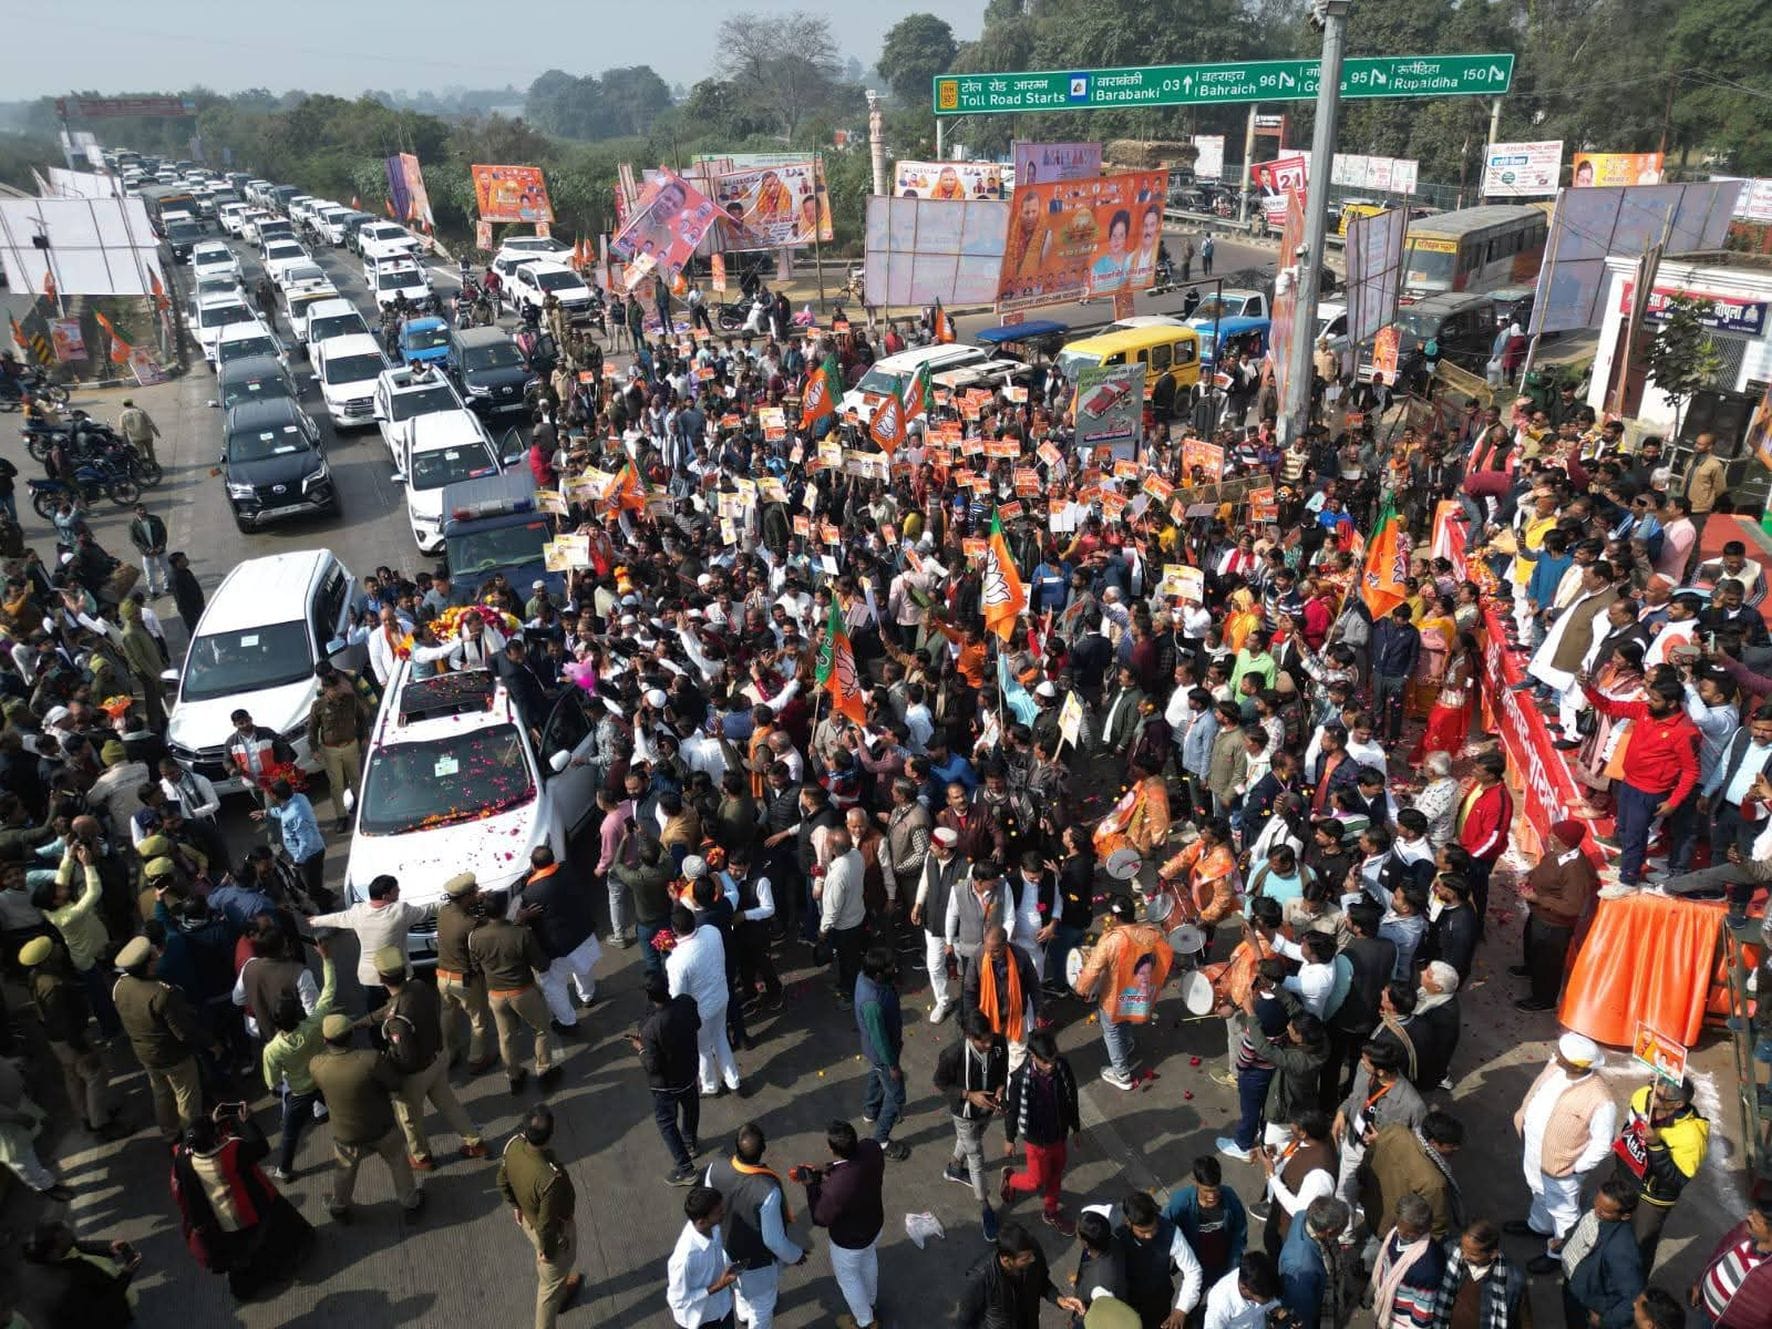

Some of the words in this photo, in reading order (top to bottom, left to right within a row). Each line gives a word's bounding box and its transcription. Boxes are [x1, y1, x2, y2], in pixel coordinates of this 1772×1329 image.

[961, 80, 982, 94] टोल
[988, 78, 1007, 92] रोड
[1200, 81, 1257, 96] Bahraich
[1259, 74, 1277, 87] 96
[1350, 71, 1369, 84] 95
[1394, 77, 1459, 92] Rupaidiha
[1463, 67, 1486, 81] 150
[960, 95, 986, 107] Toll
[989, 93, 1022, 106] Road
[1025, 92, 1066, 105] Starts
[1096, 88, 1161, 101] Barabanki
[1162, 79, 1181, 92] 03
